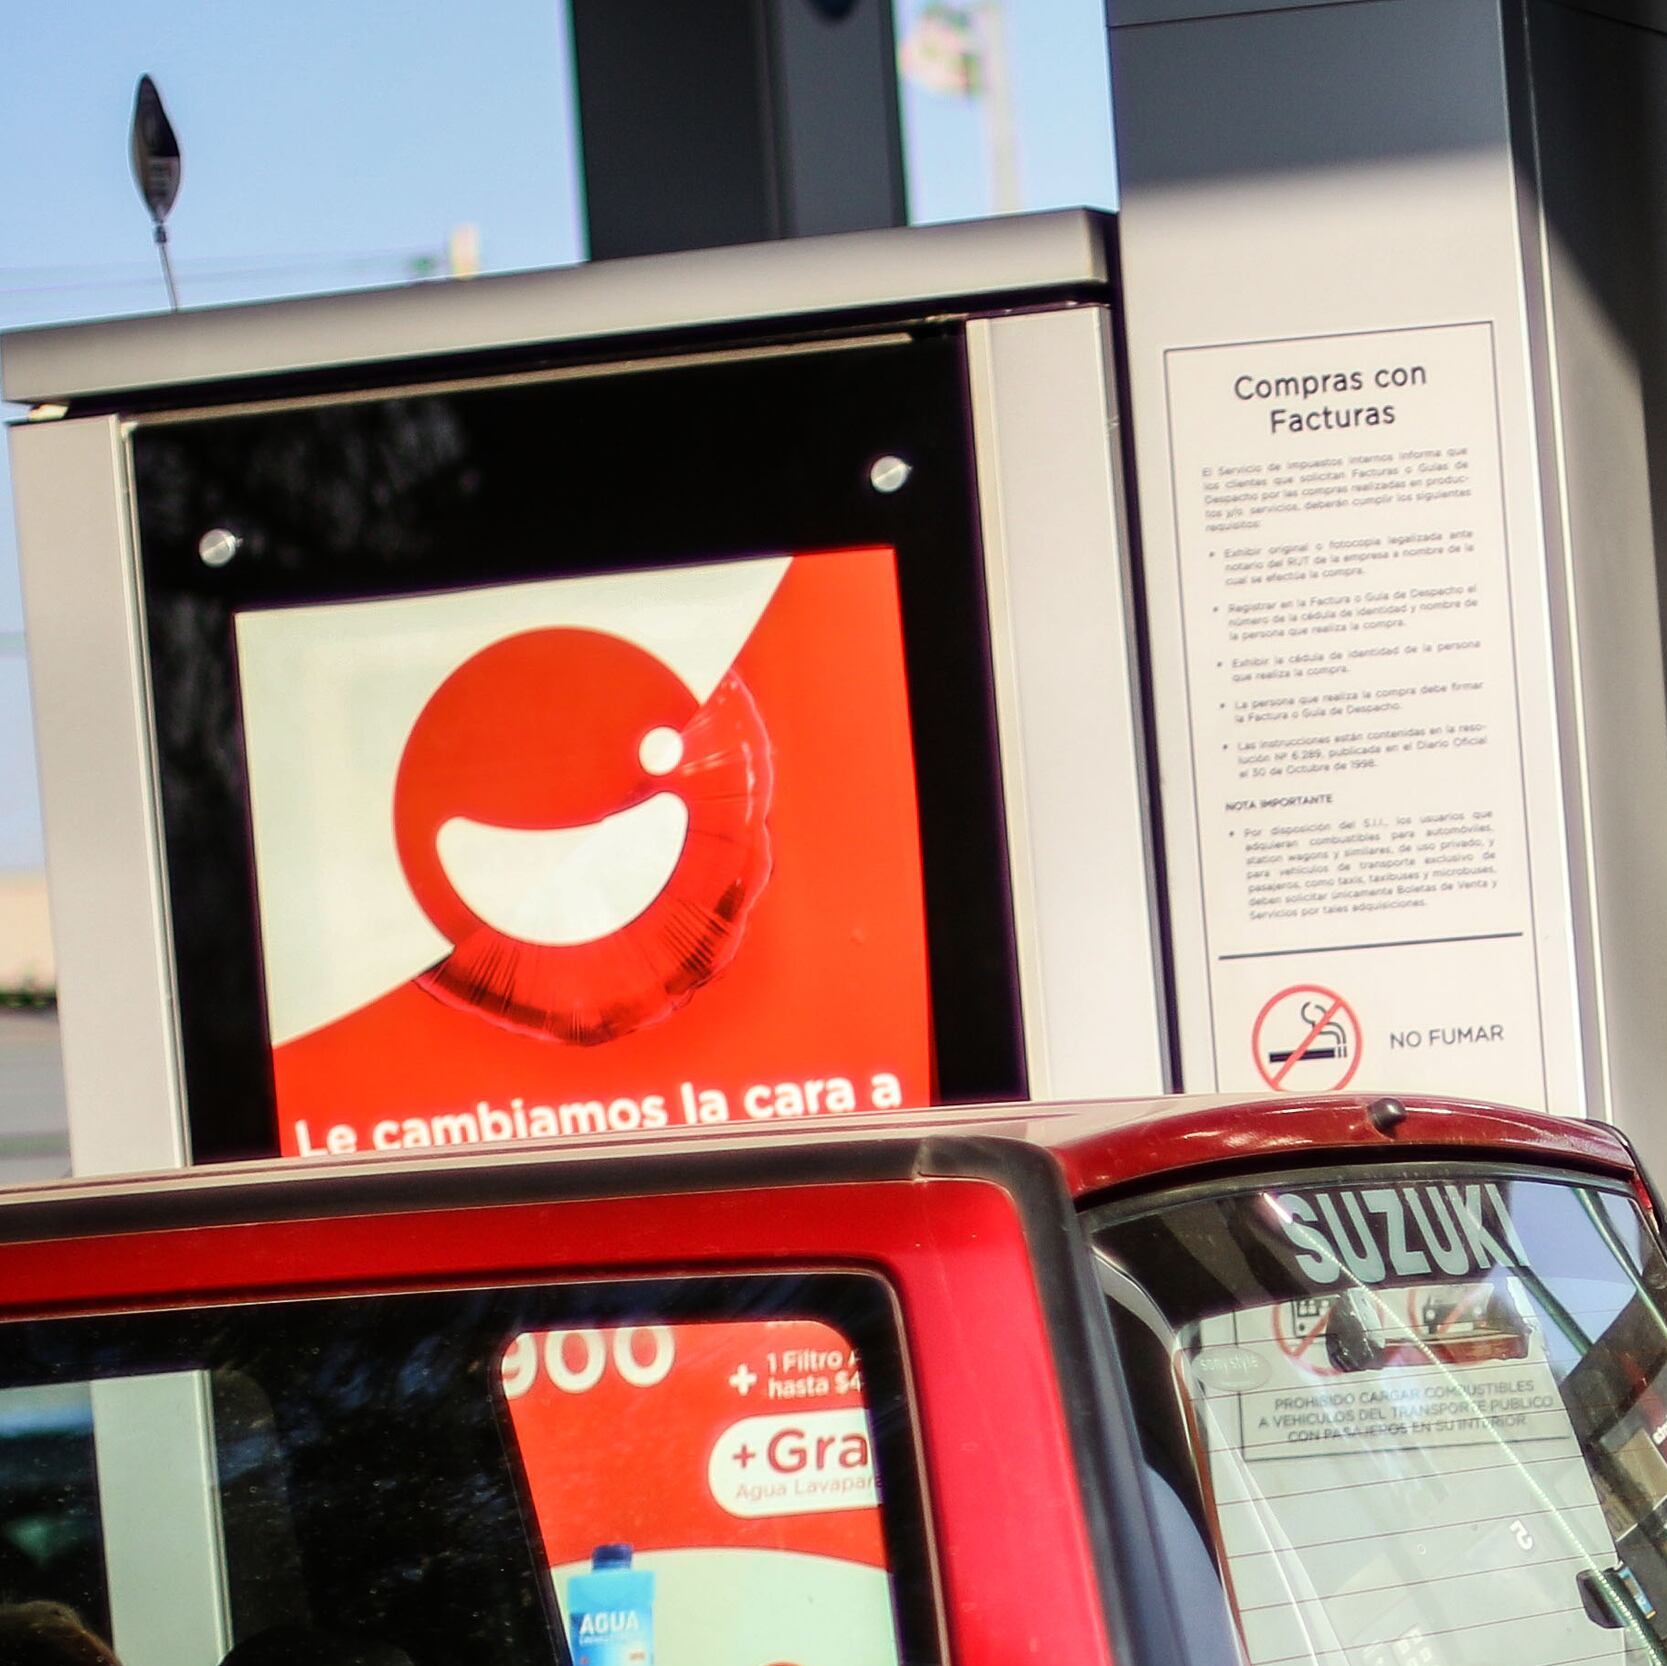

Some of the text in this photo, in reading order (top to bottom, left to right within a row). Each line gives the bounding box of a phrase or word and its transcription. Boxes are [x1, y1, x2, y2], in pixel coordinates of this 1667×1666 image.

[1234, 365, 1426, 400] Compras con
[1271, 404, 1396, 434] Facturas
[1224, 793, 1333, 811] NOTA IMPORTANTE
[1390, 1024, 1505, 1050] NO FUMAR
[295, 1070, 902, 1158] Le cambiamos la cara a
[1277, 1184, 1530, 1284] SUZUKI
[783, 1349, 843, 1374] Filtro
[767, 1374, 830, 1400] hasta
[1275, 1380, 1535, 1411] PROHIBIDO CARGAR COMBUSTIBLES
[1359, 1409, 1385, 1421] DEL
[1392, 1400, 1487, 1419] TRANSPORTE
[1288, 1429, 1321, 1442] CON
[1412, 1421, 1431, 1433] EN
[1436, 1420, 1454, 1431] SU
[736, 1481, 787, 1501] Agua
[580, 1610, 639, 1633] AGUA
